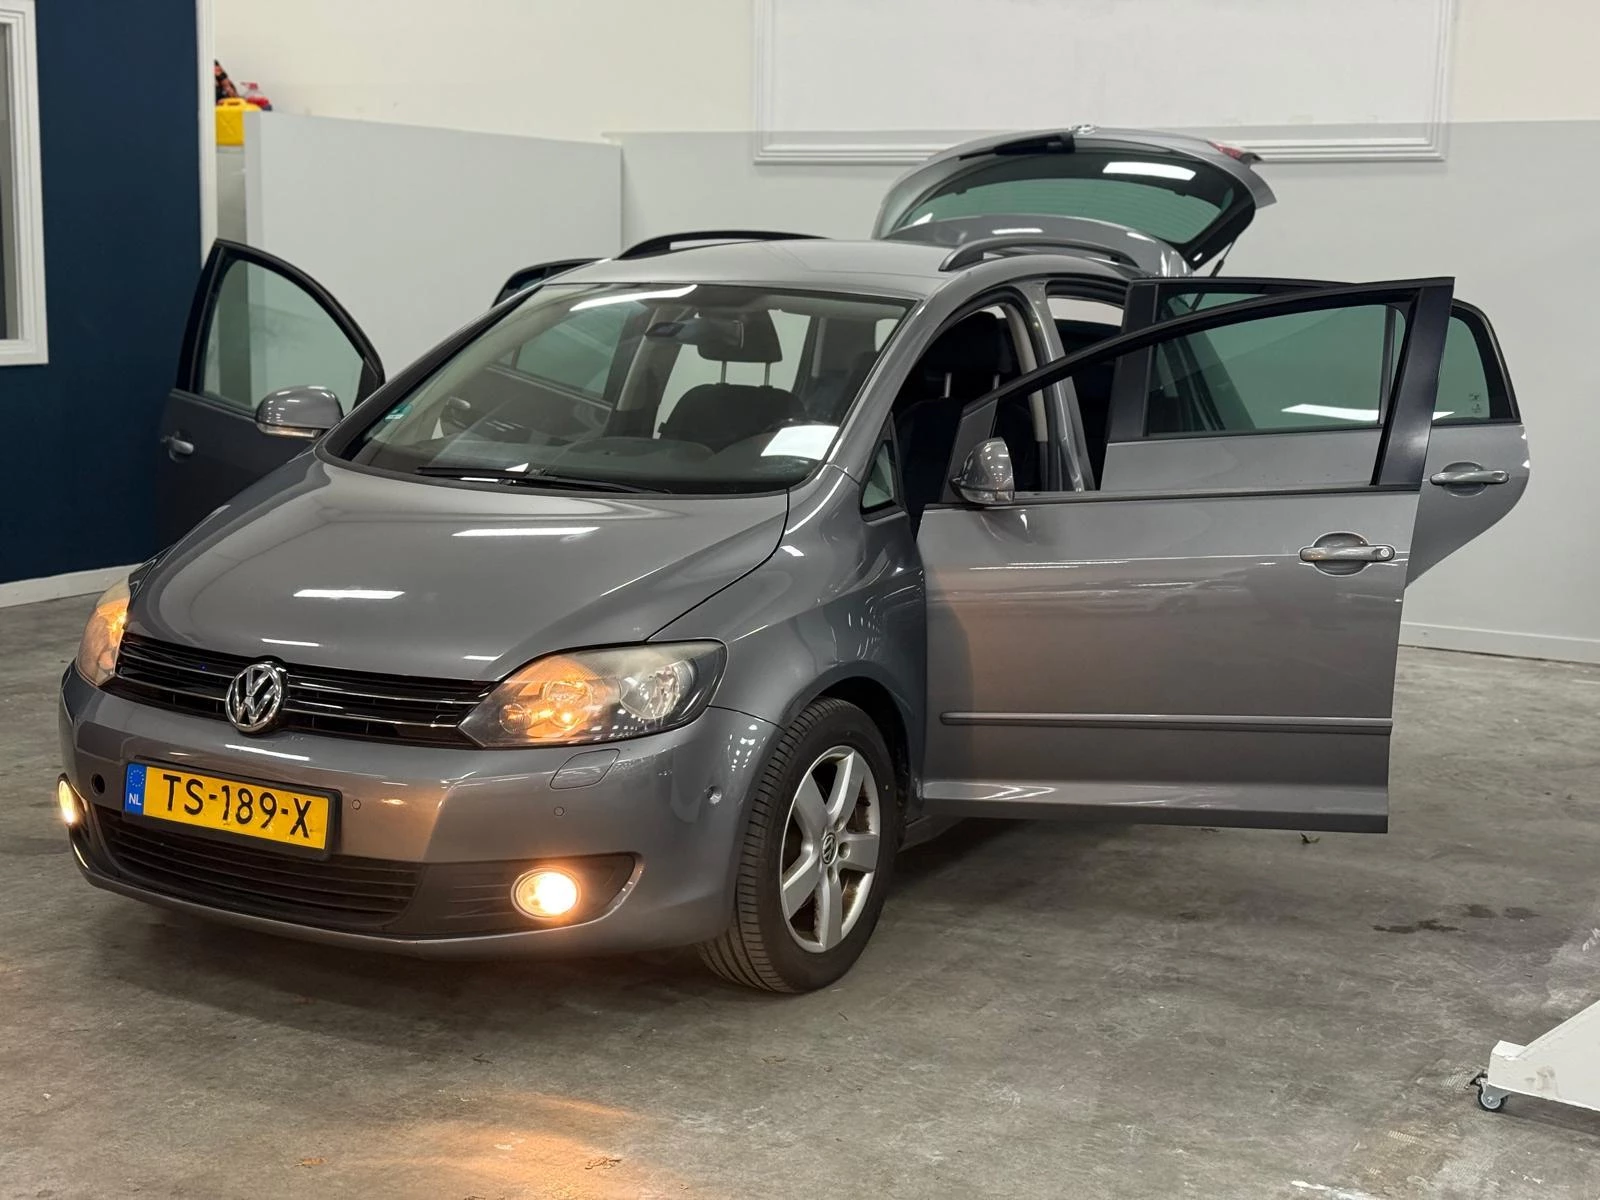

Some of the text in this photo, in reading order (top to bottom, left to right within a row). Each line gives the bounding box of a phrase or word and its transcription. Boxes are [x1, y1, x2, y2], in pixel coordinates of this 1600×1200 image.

[227, 665, 280, 730] VW
[128, 792, 142, 806] NL
[162, 773, 312, 839] TS-189-X
